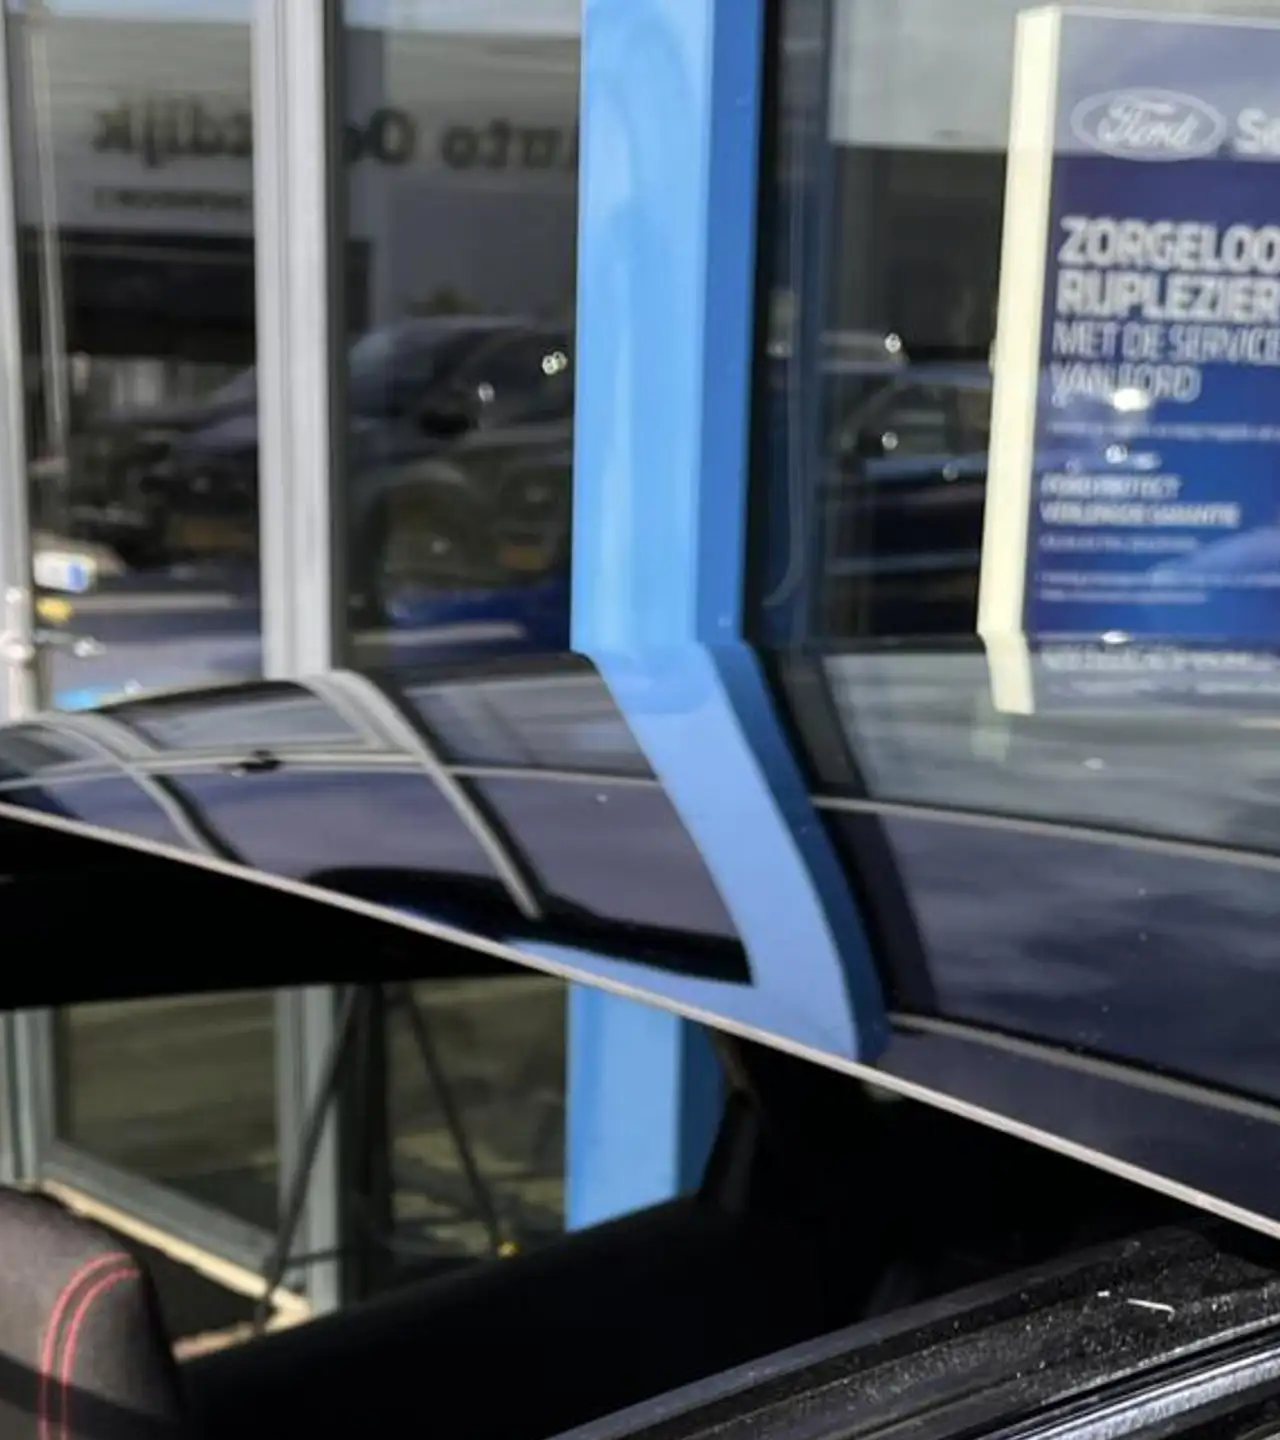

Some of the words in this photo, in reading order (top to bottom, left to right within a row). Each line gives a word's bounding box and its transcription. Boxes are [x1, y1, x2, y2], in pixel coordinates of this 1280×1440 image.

[1098, 98, 1201, 149] Ford
[1052, 320, 1118, 359] MET
[1122, 321, 1164, 361] DE
